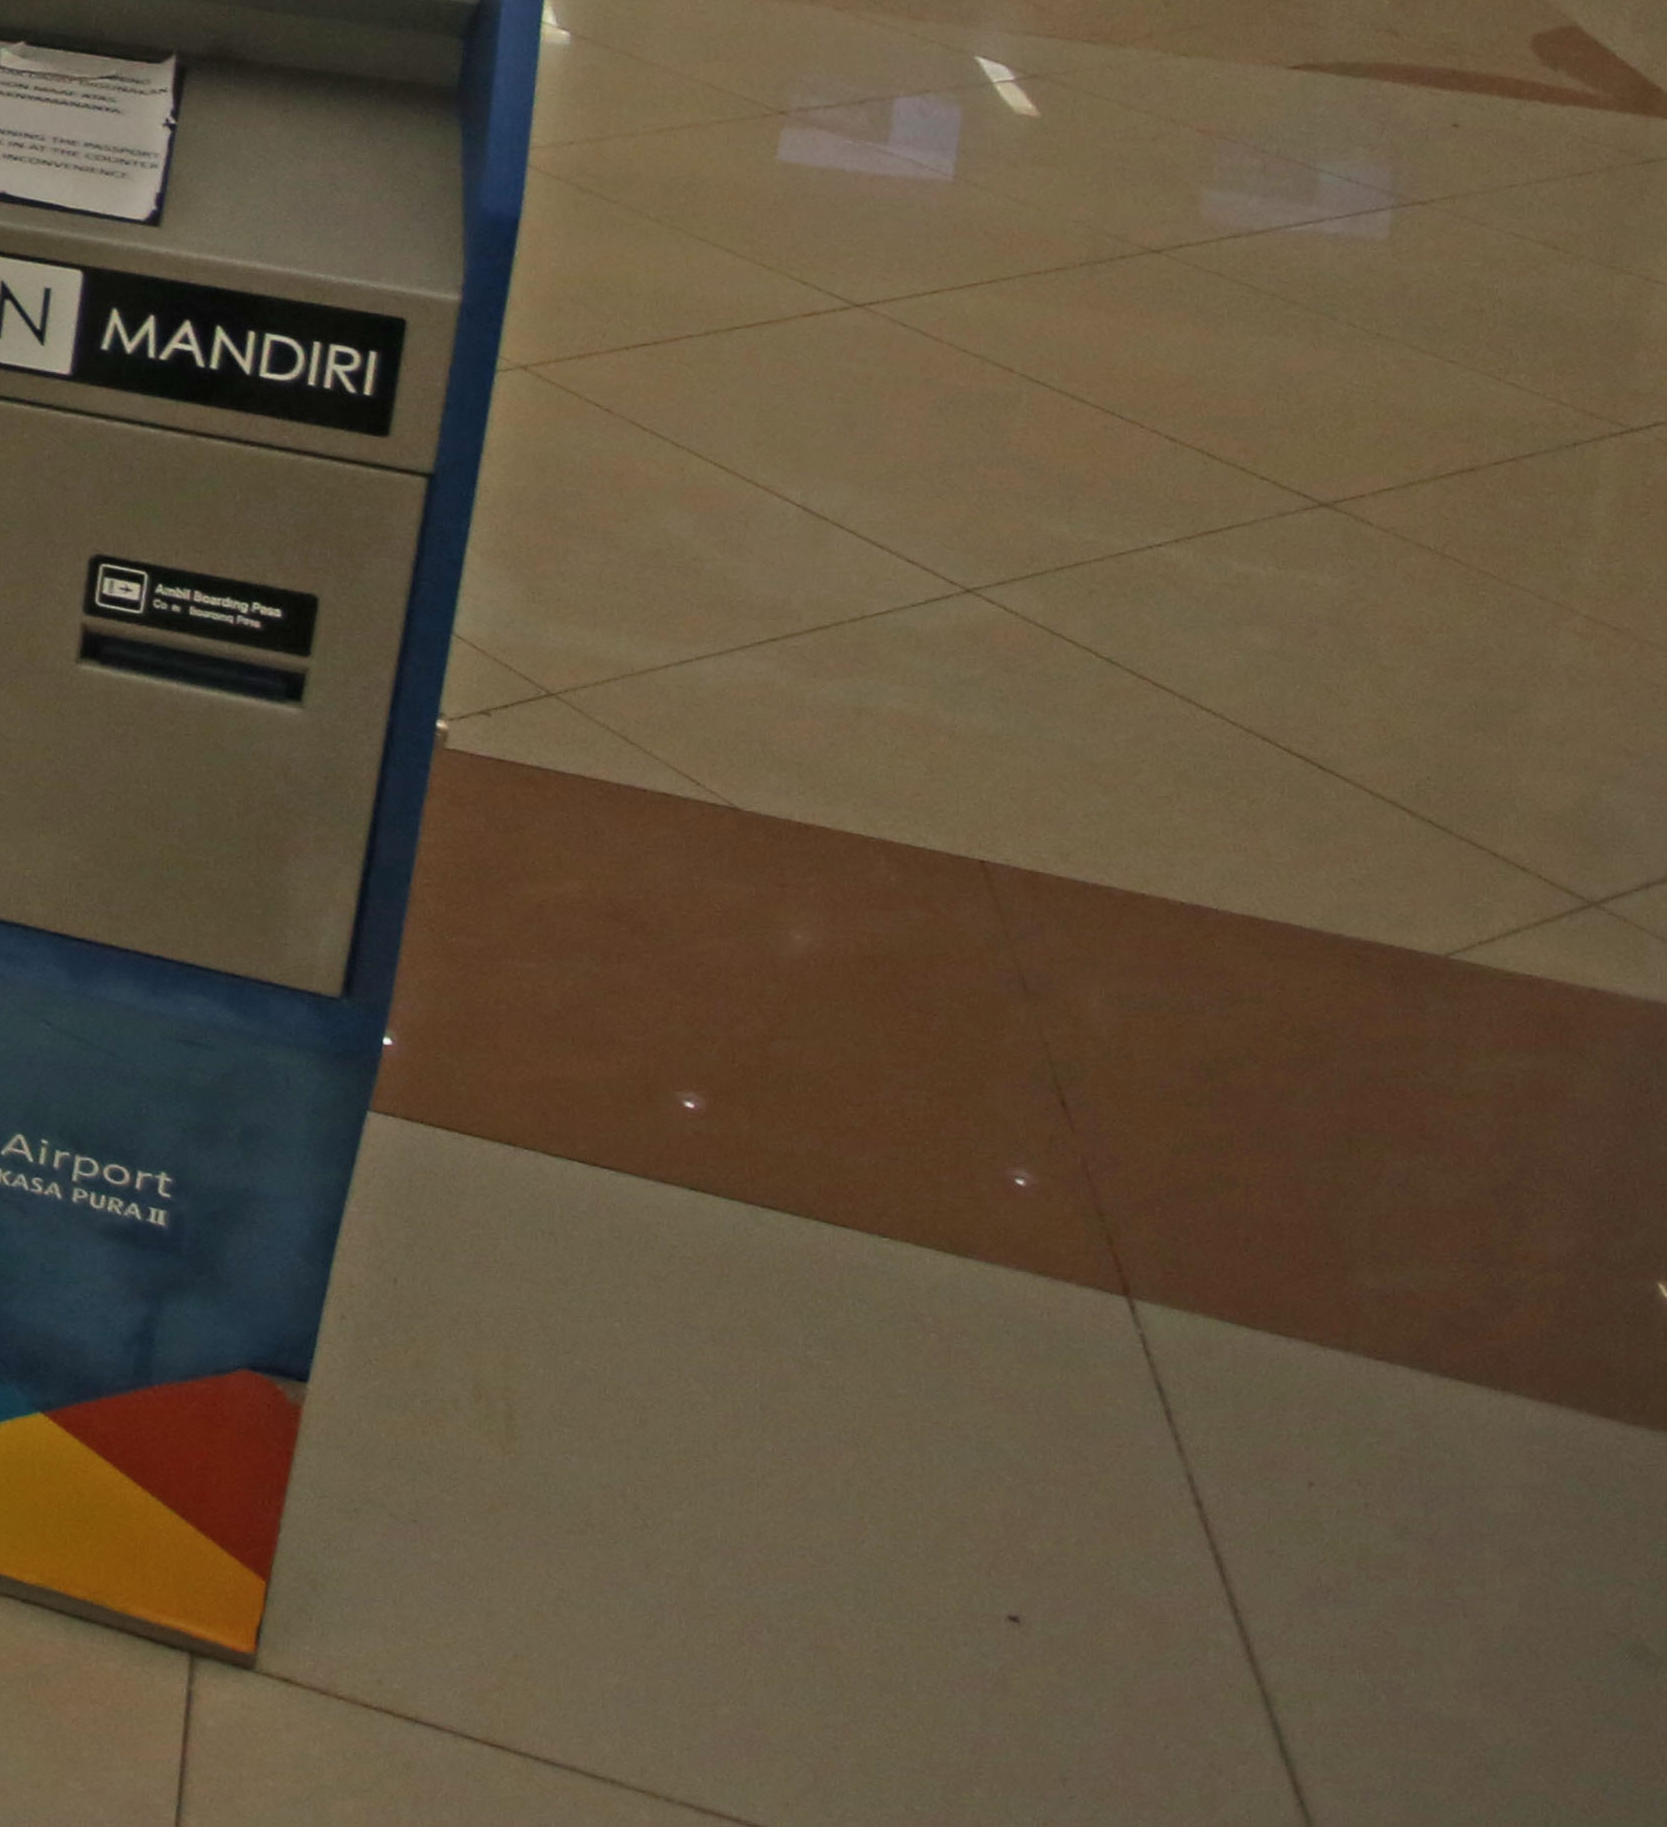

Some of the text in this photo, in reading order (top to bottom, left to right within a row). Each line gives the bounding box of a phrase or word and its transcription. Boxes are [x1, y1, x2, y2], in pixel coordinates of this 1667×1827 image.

[99, 307, 377, 399] MANDIRI
[155, 583, 283, 618] Ambil Boarding Pass
[1, 1133, 173, 1199] Airport
[71, 1187, 143, 1221] PURA
